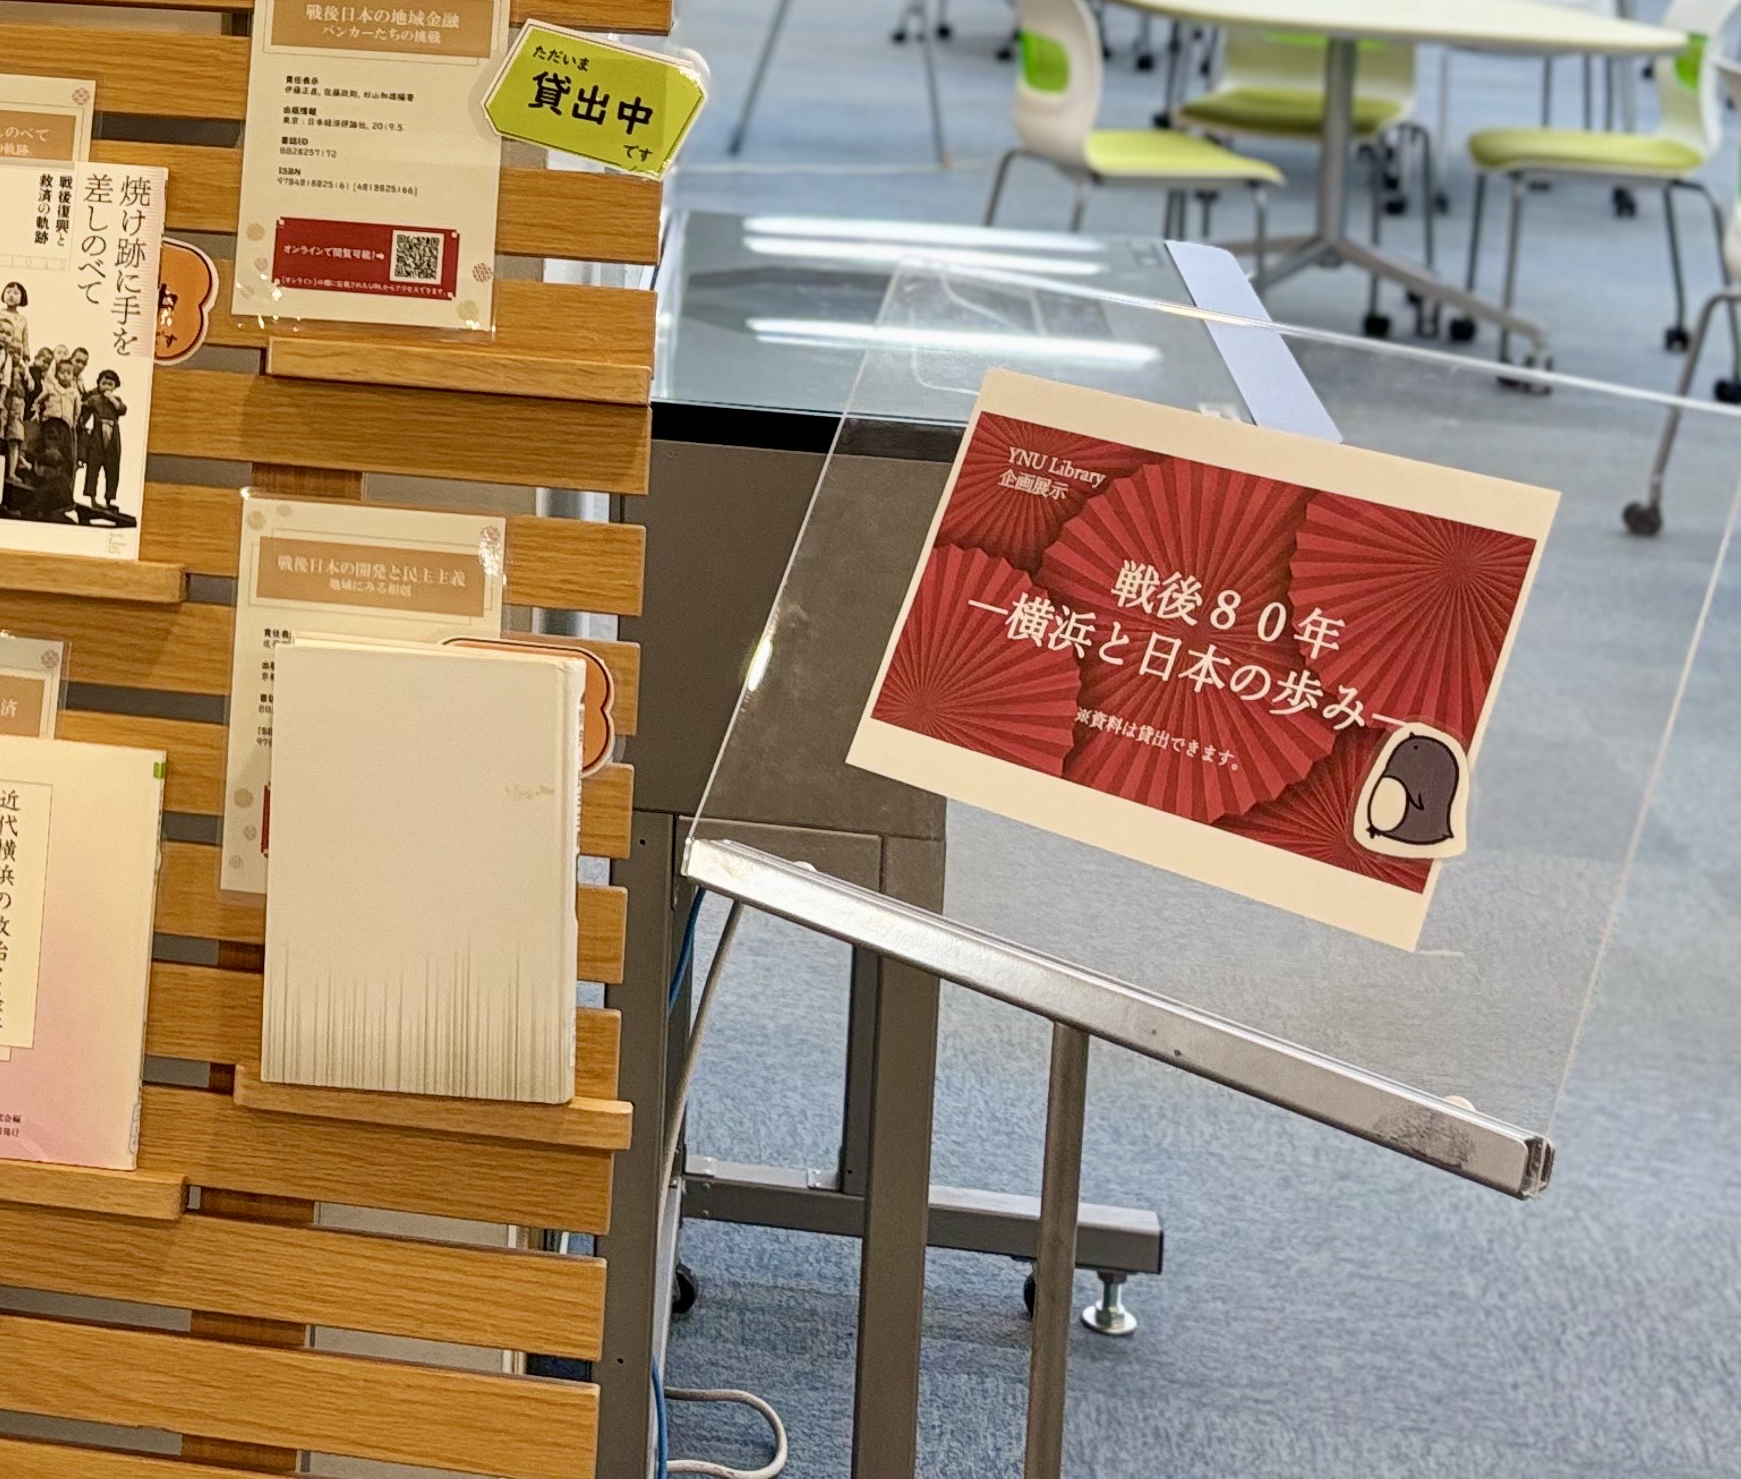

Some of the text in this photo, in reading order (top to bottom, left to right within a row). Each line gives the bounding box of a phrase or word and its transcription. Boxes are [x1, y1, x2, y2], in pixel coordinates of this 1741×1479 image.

[305, 3, 460, 31] 戦後日本の地域金融
[532, 44, 591, 73] ただいま
[527, 69, 655, 137] 貸出中
[622, 143, 653, 164] です
[34, 173, 54, 246] 救済の軌跡
[55, 174, 73, 248] 戦後復興と
[77, 172, 114, 306] 差しのべて
[110, 175, 152, 357] 焼け跡に手を
[997, 467, 1070, 502] 企画展示
[1008, 446, 1107, 490] YNU Library
[277, 554, 467, 588] 戦後日本の開発と民主主義
